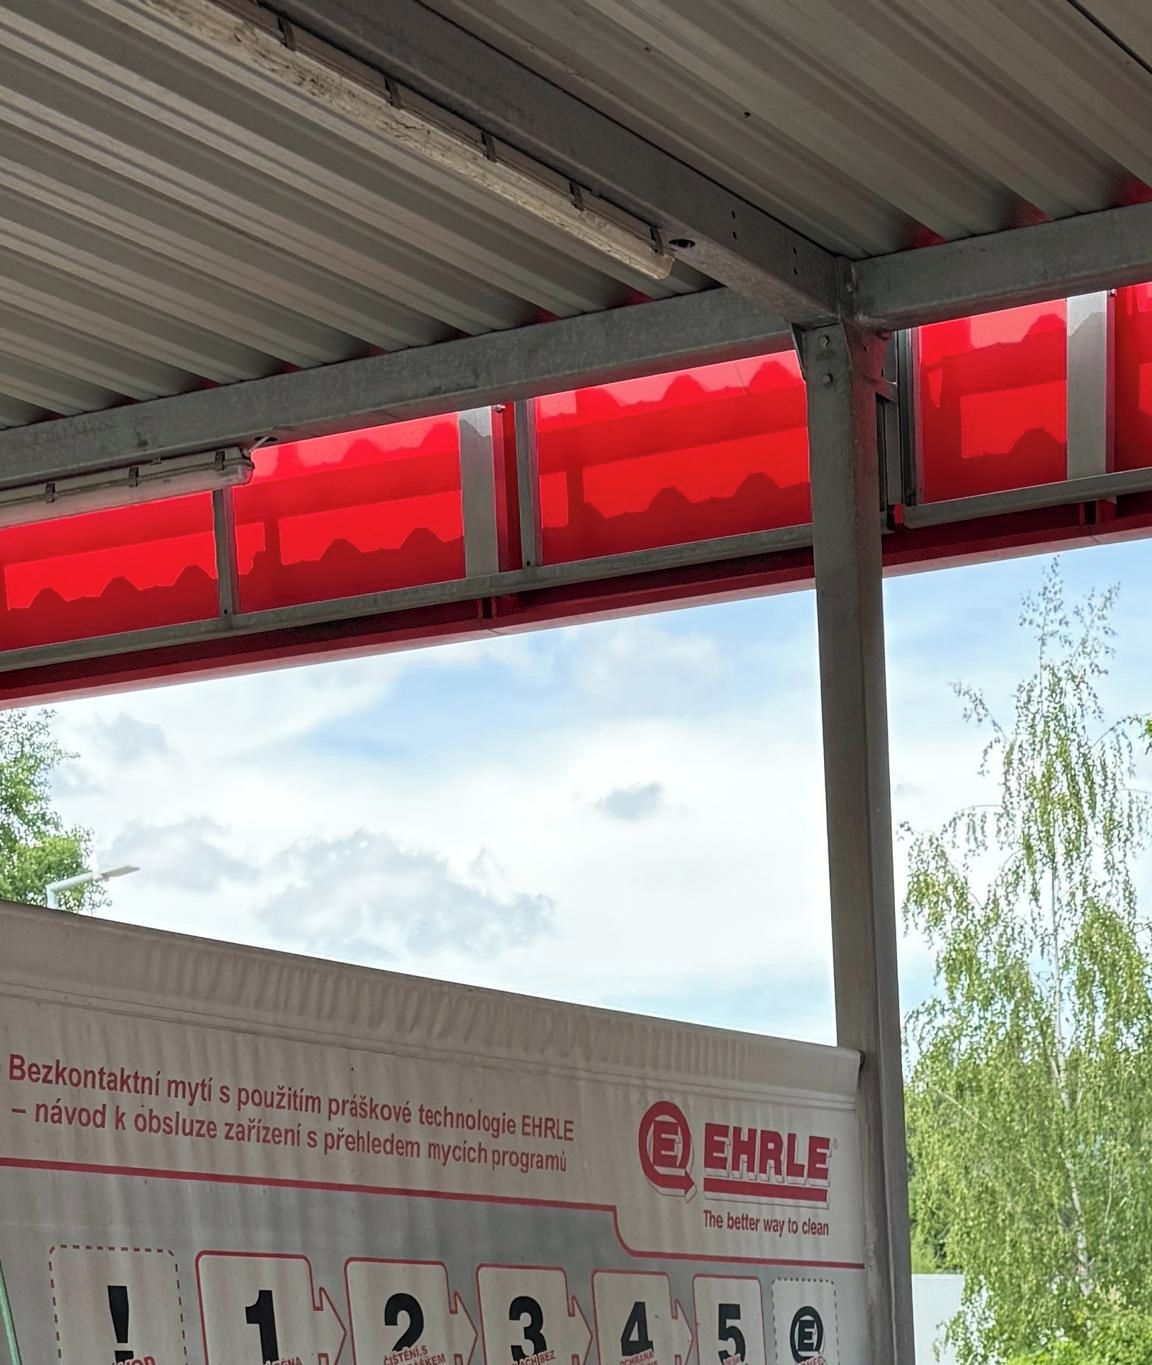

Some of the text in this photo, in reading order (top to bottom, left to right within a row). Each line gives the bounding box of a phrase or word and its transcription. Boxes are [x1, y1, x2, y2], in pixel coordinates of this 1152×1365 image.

[9, 1054, 574, 1141] Bezkontaktní mytí s použitím práškové technologie EHRLE
[35, 1099, 106, 1128] návod
[115, 1106, 126, 1130] k
[134, 1109, 217, 1138] obsluze
[224, 1118, 300, 1146] zařízení
[307, 1131, 317, 1149] s
[325, 1127, 420, 1158] přehledem
[428, 1140, 487, 1166] mycích
[492, 1150, 566, 1173] programů
[705, 1123, 830, 1180] EHRLE
[704, 1210, 829, 1237] The better way to clean
[245, 1290, 279, 1364] 1
[384, 1293, 424, 1351] 2
[509, 1296, 547, 1361] 3
[621, 1301, 654, 1356] 4
[718, 1303, 745, 1365] 5
